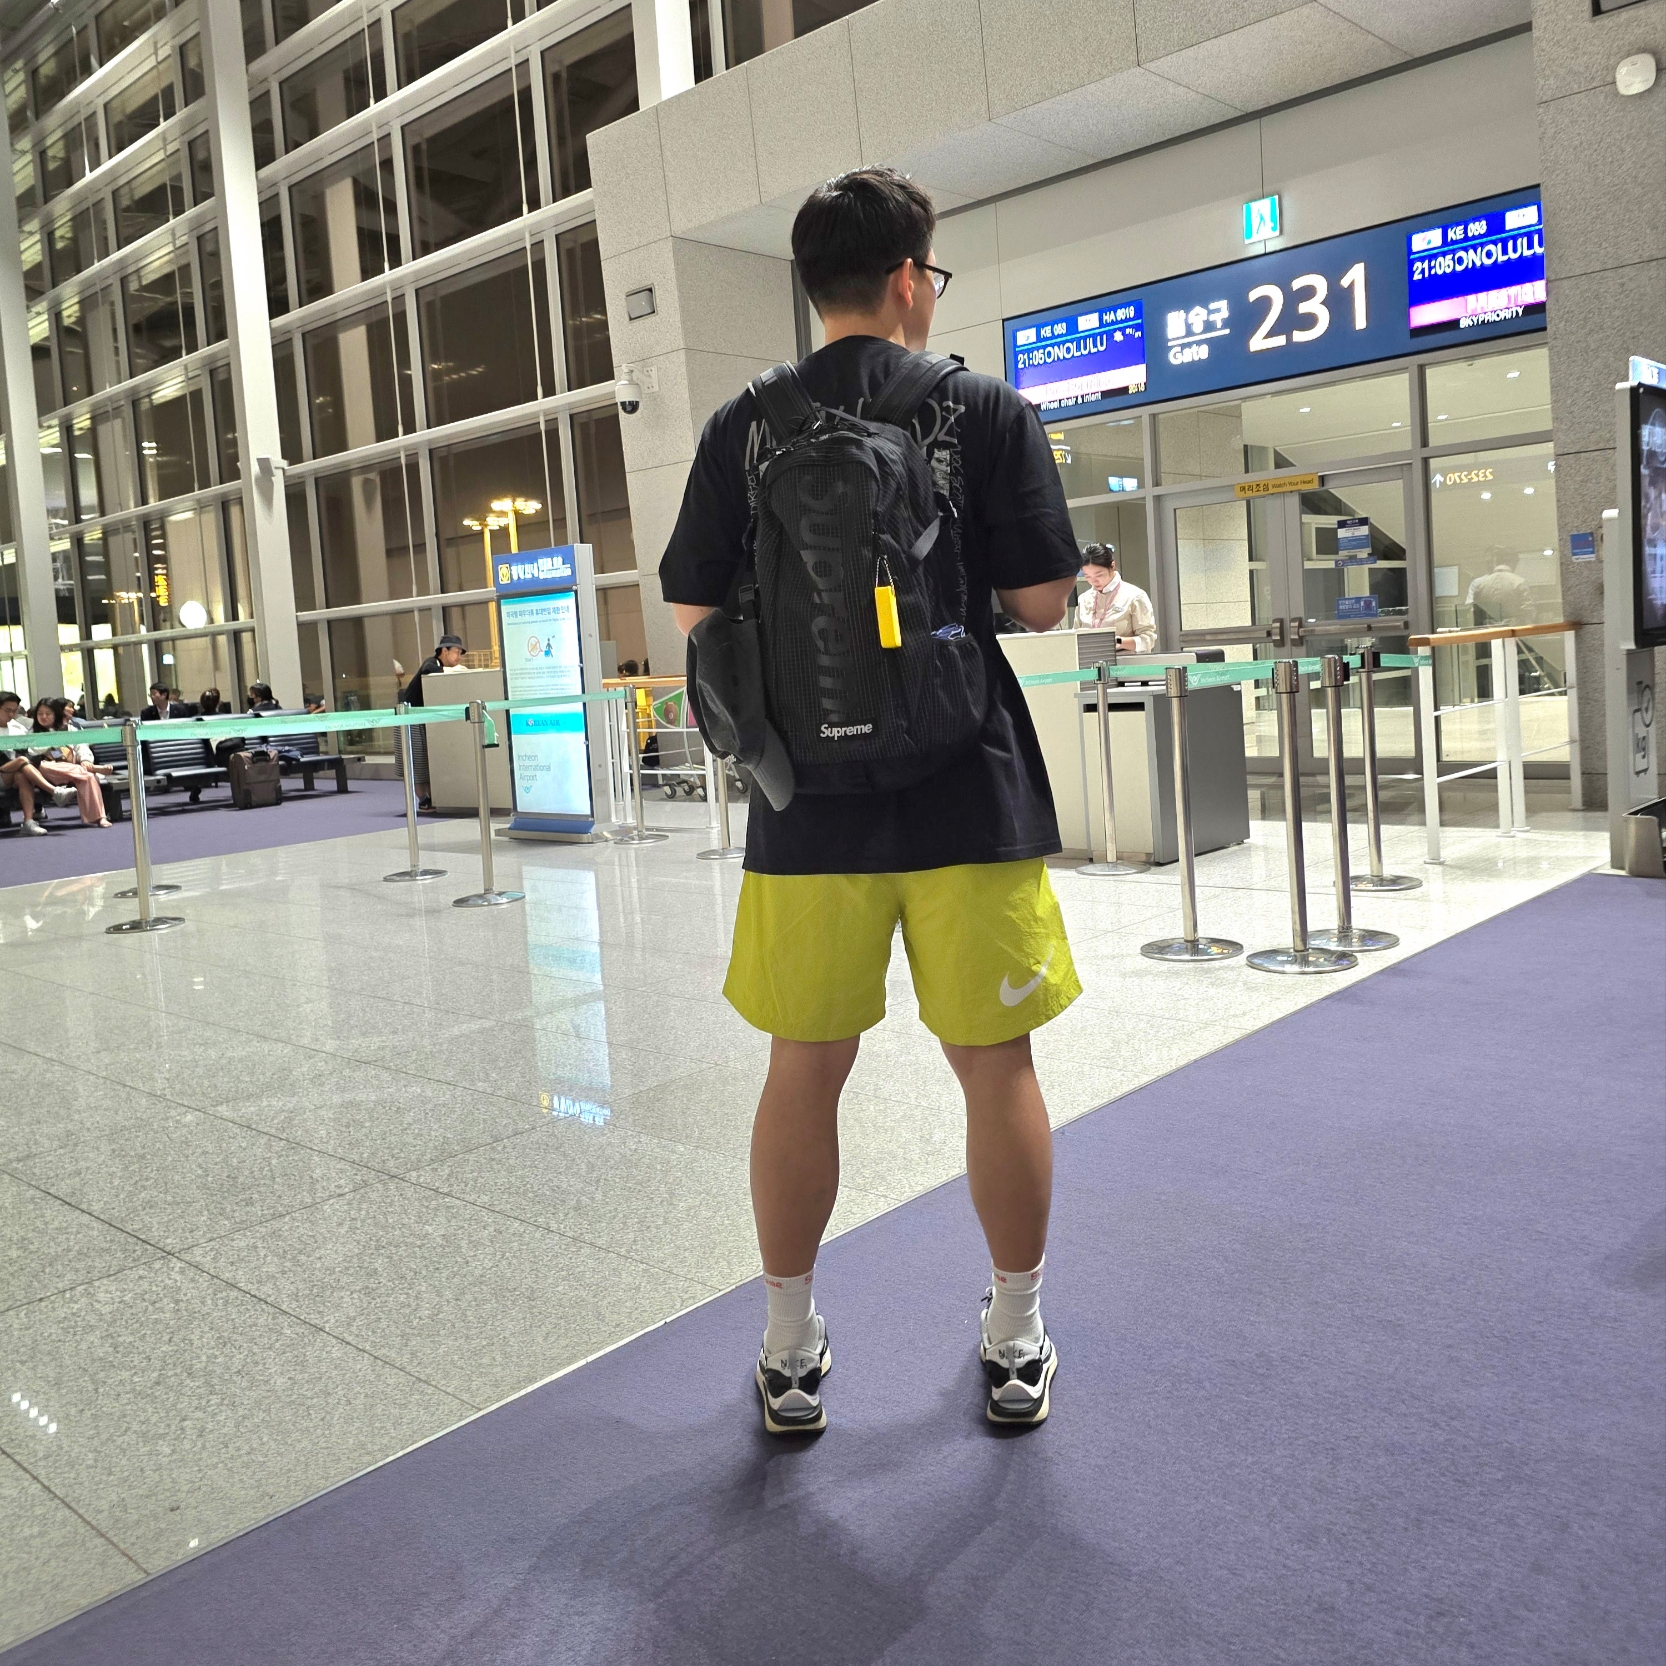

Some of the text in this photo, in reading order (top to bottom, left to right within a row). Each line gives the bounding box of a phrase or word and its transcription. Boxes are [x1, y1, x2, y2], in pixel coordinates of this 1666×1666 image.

[1448, 225, 1464, 242] KE
[1248, 262, 1367, 352] 231
[1041, 325, 1052, 338] KE
[1103, 310, 1116, 324] HA
[1169, 343, 1209, 365] Gate
[1240, 482, 1270, 494] 머리조심
[799, 475, 862, 722] Suprem
[819, 722, 874, 739] Supreme
[517, 753, 539, 762] Incheon
[518, 763, 551, 772] International
[519, 773, 538, 783] Airport
